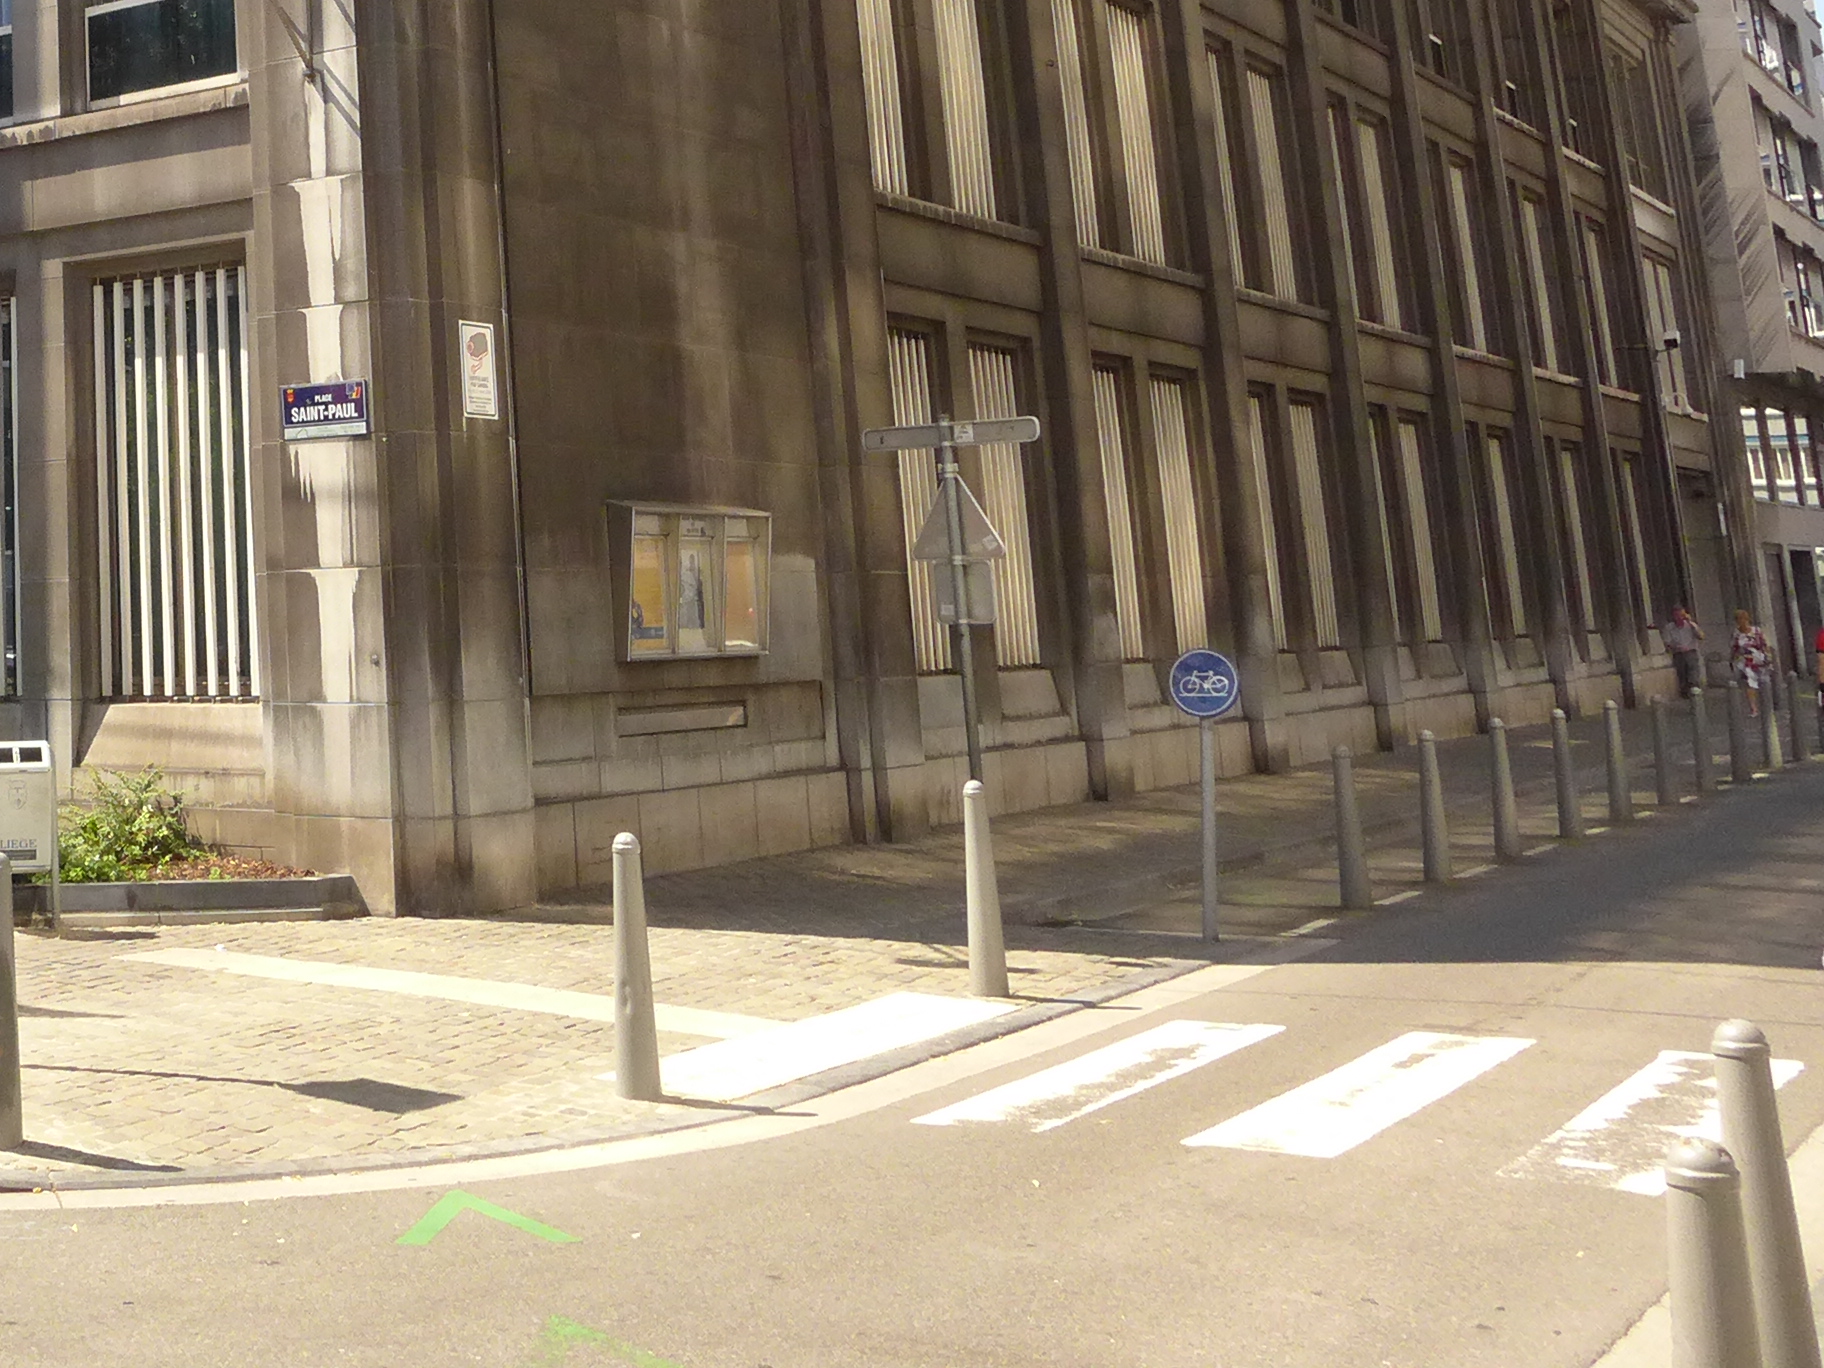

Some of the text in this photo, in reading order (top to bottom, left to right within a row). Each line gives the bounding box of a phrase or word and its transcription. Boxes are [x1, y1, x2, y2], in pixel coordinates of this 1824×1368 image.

[314, 393, 332, 403] PLACE
[291, 403, 358, 423] SAINT-PAUL
[0, 838, 37, 849] LIEGE
